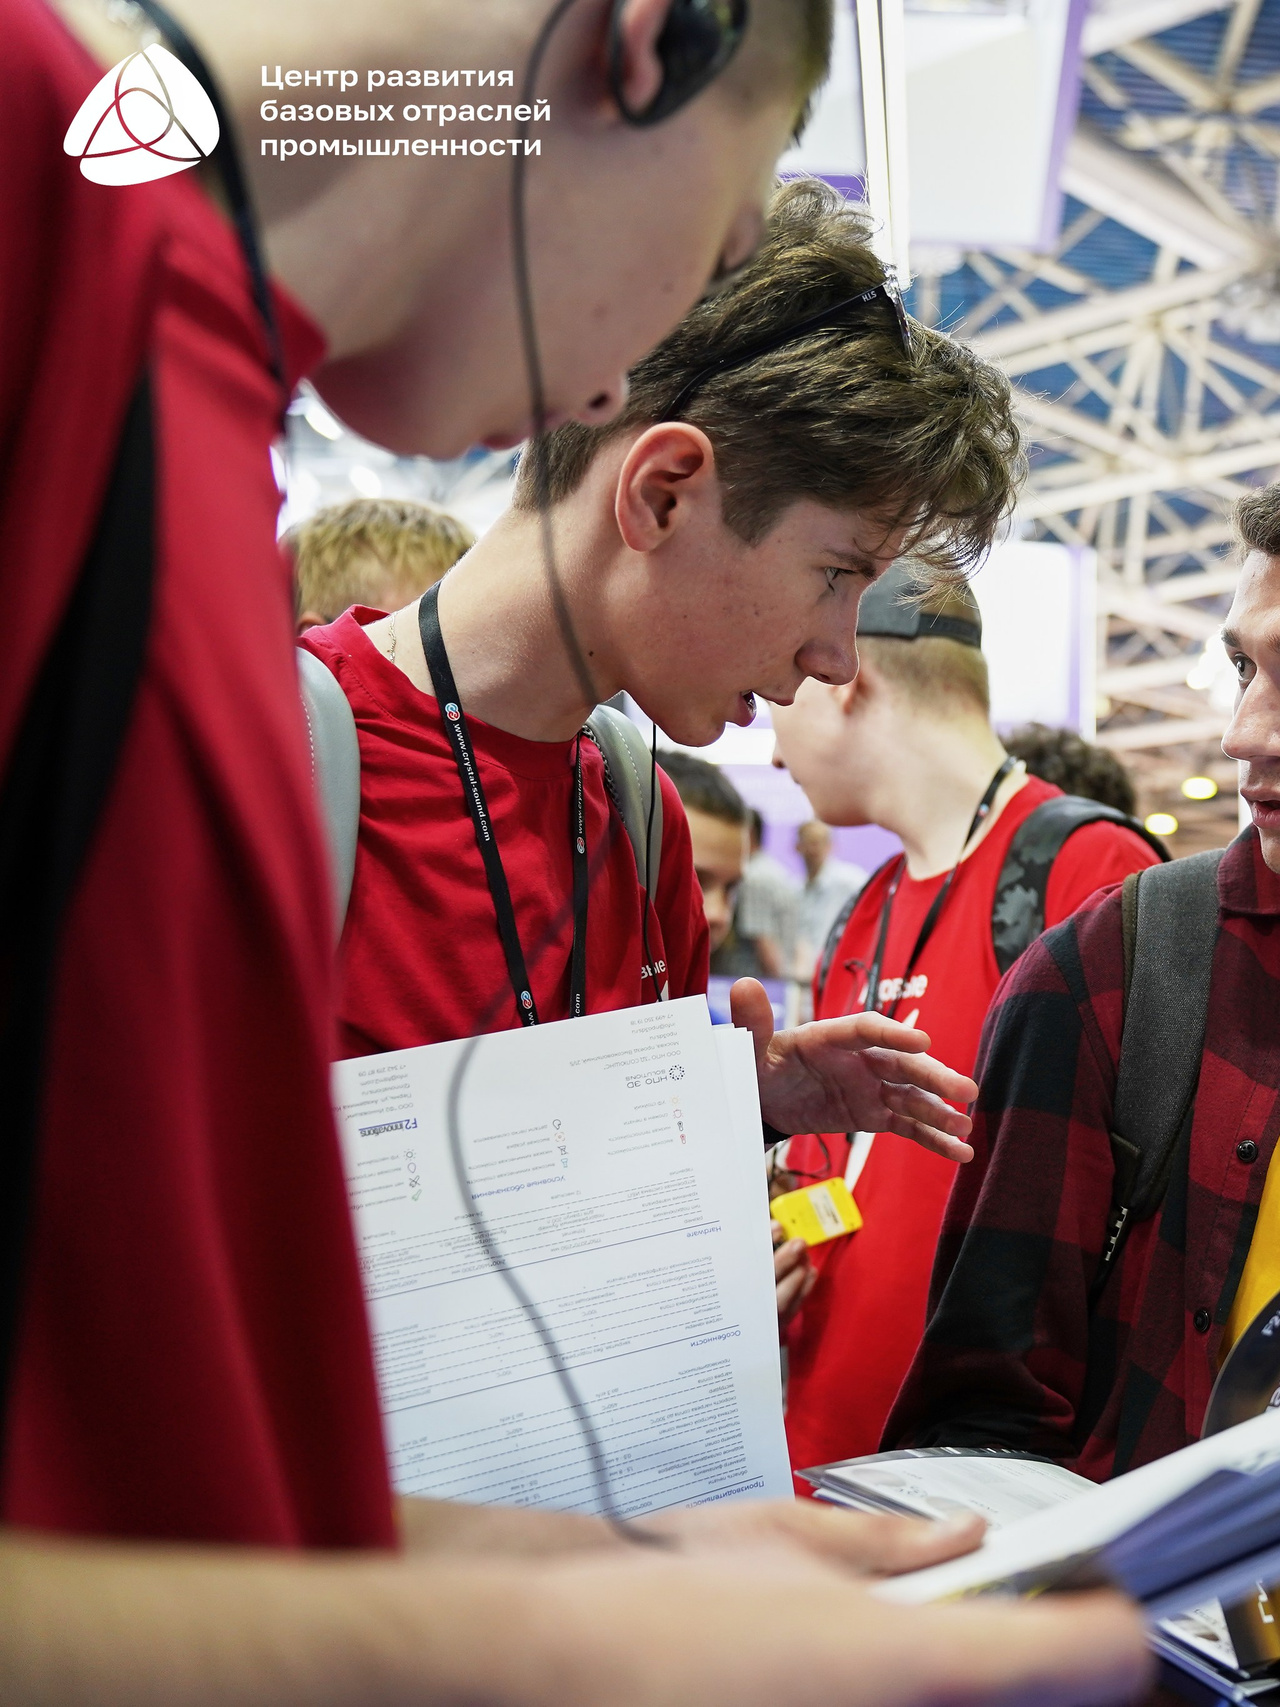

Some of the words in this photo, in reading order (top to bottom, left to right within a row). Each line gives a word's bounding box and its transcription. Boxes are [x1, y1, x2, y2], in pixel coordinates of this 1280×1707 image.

[453, 723, 490, 842] www.crystal-sound.com
[624, 1068, 666, 1081] SOLUTIONS
[643, 1074, 668, 1085] НПО
[625, 1079, 641, 1089] 3D
[402, 1117, 418, 1130] F2
[525, 1174, 566, 1189] Условные
[470, 1182, 526, 1200] обозначения
[685, 1224, 722, 1239] Hardware
[689, 1328, 741, 1348] Особенности
